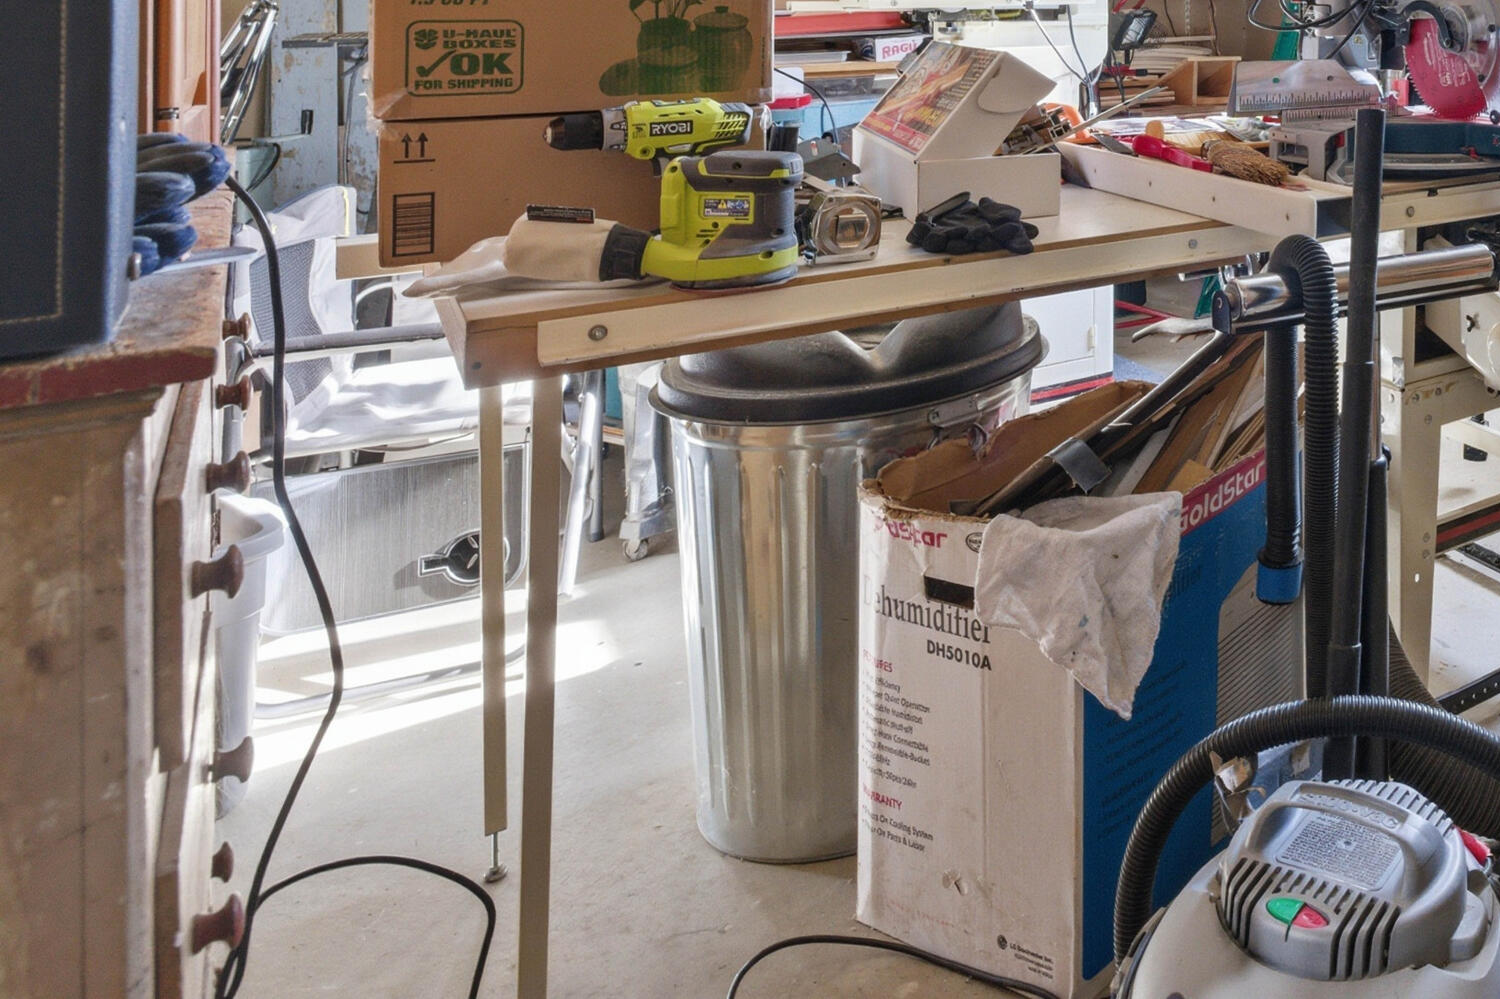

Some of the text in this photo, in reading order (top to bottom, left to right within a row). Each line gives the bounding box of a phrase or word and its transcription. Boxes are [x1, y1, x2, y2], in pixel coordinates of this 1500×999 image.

[442, 28, 517, 40] U-HAUL
[442, 39, 517, 50] BOXES
[449, 52, 514, 77] OK
[414, 77, 513, 91] FOR SHIPPING
[651, 121, 691, 135] RYOBI
[926, 639, 992, 671] DH5010A
